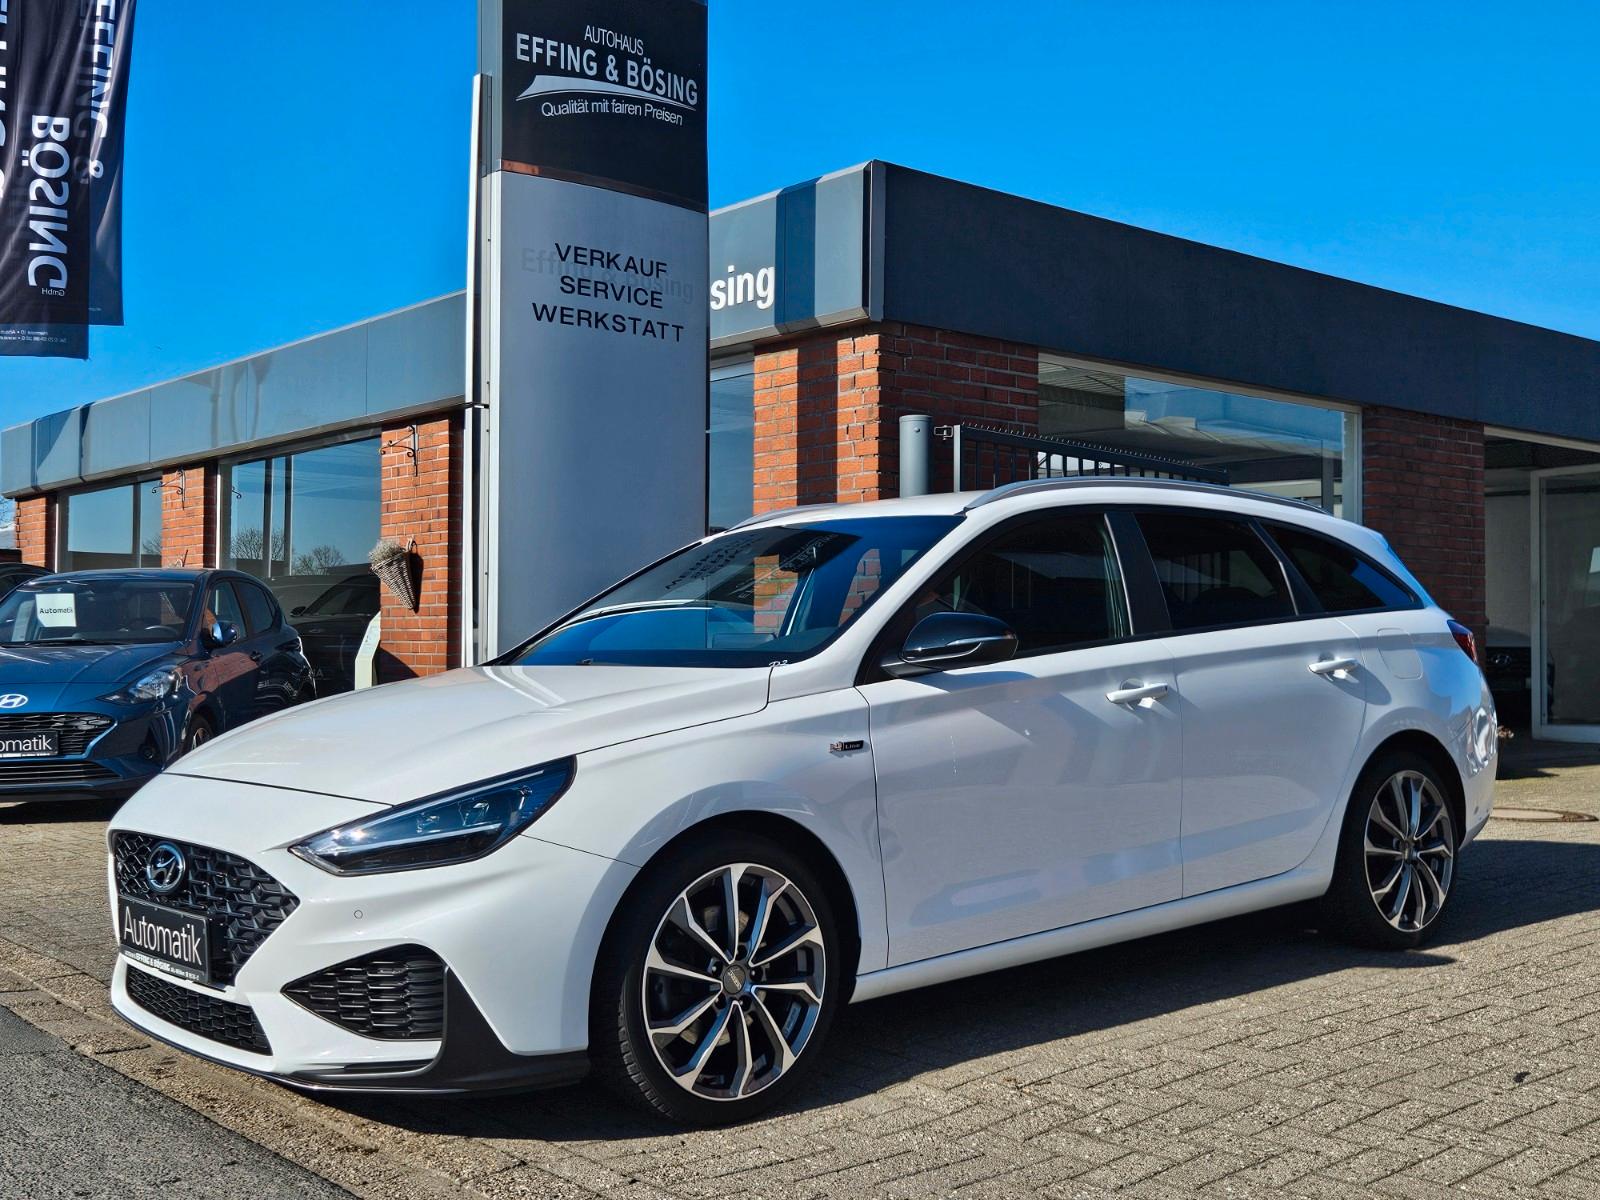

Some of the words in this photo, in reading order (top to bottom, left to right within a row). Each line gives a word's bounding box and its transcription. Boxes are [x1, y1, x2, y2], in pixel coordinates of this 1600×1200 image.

[584, 24, 644, 56] AUTOHAUS
[516, 32, 598, 77] EFFING
[605, 54, 619, 83] &
[626, 57, 698, 106] BÖSING
[541, 99, 589, 117] Qualität
[591, 98, 609, 113] mit
[610, 99, 642, 116] fairen
[644, 103, 683, 126] Preisen
[555, 242, 668, 279] VERKAUF
[559, 275, 663, 309] SERVICE
[710, 265, 775, 310] sing
[531, 302, 684, 343] WERKSTATT
[123, 905, 202, 966] Automatik
